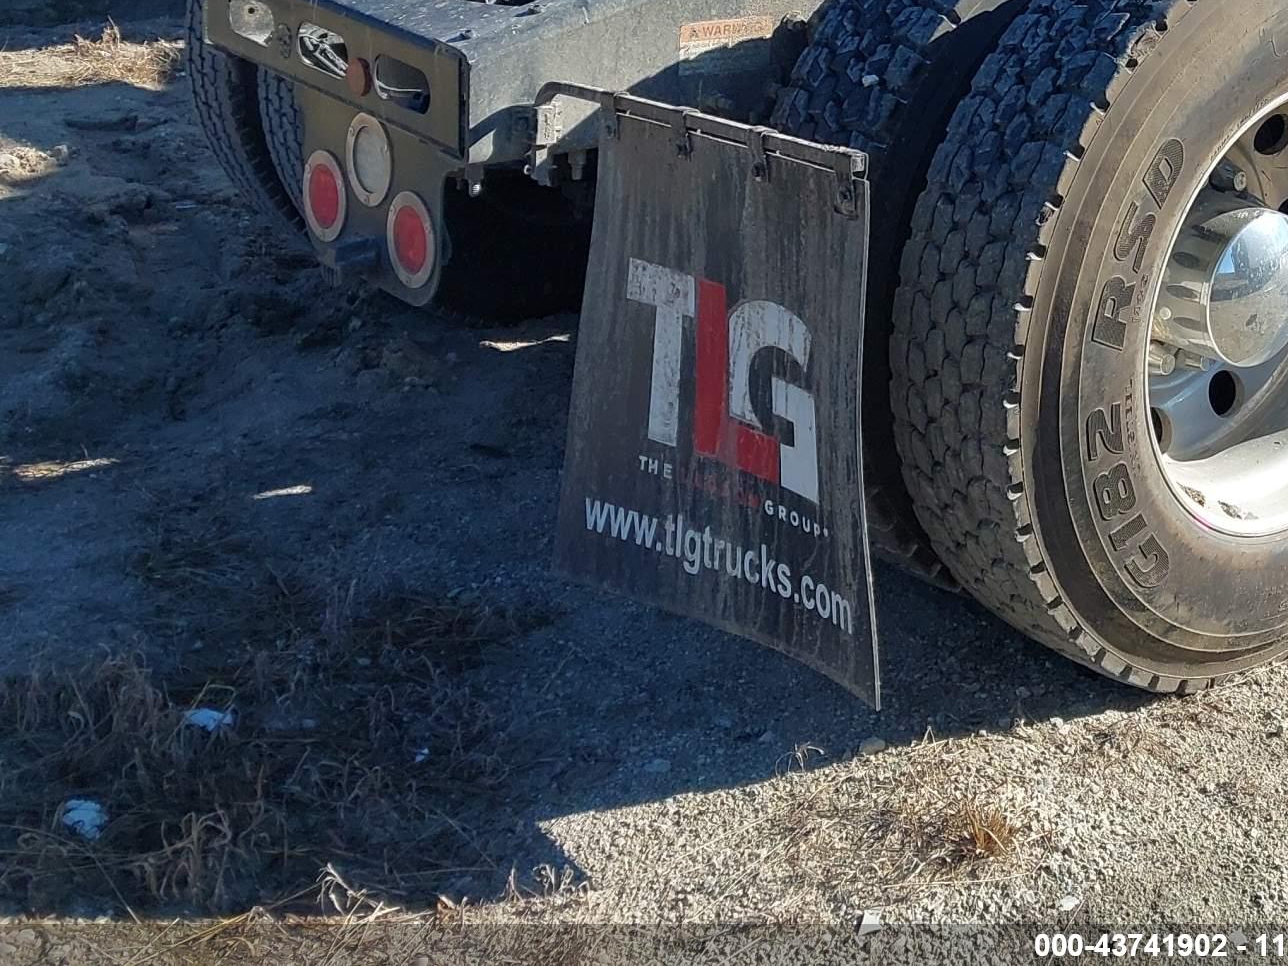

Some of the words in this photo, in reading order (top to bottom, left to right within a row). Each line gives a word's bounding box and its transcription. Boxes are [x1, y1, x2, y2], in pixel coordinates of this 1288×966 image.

[1091, 137, 1186, 352] RSD
[626, 257, 818, 505] TLG
[638, 455, 673, 480] THE
[584, 497, 853, 635] www.tlgtrucks.com
[1086, 401, 1172, 589] G182
